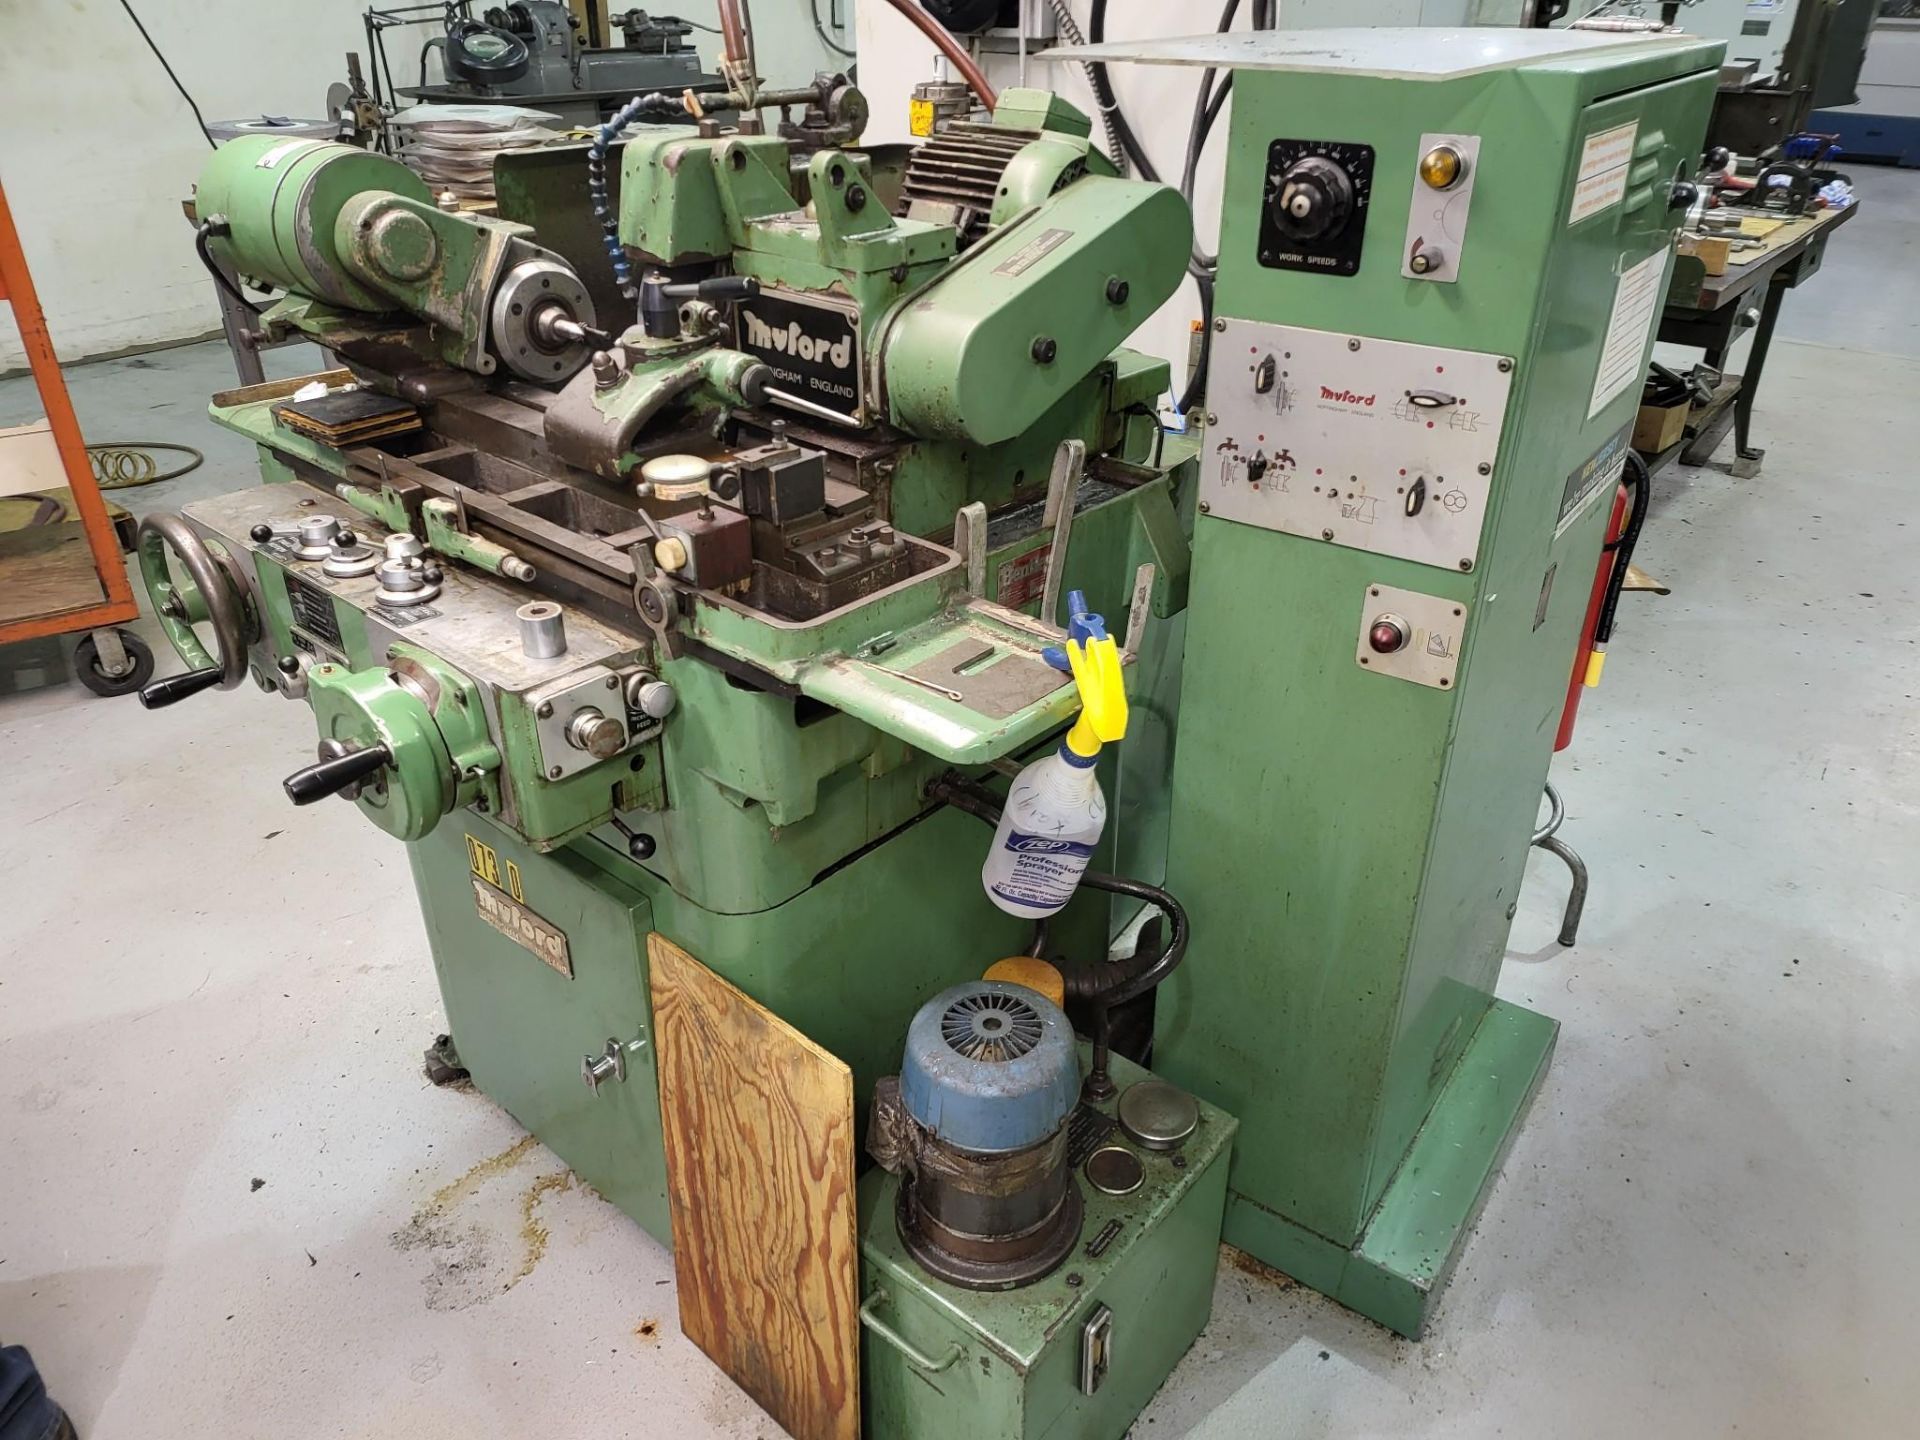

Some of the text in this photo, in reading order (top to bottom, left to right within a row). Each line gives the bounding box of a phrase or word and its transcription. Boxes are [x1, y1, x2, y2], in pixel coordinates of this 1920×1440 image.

[1279, 252, 1337, 267] WORK SPEEDS
[810, 377, 854, 399] ENGLAND
[1016, 859, 1064, 876] Sprayer
[1018, 853, 1084, 874] Profession
